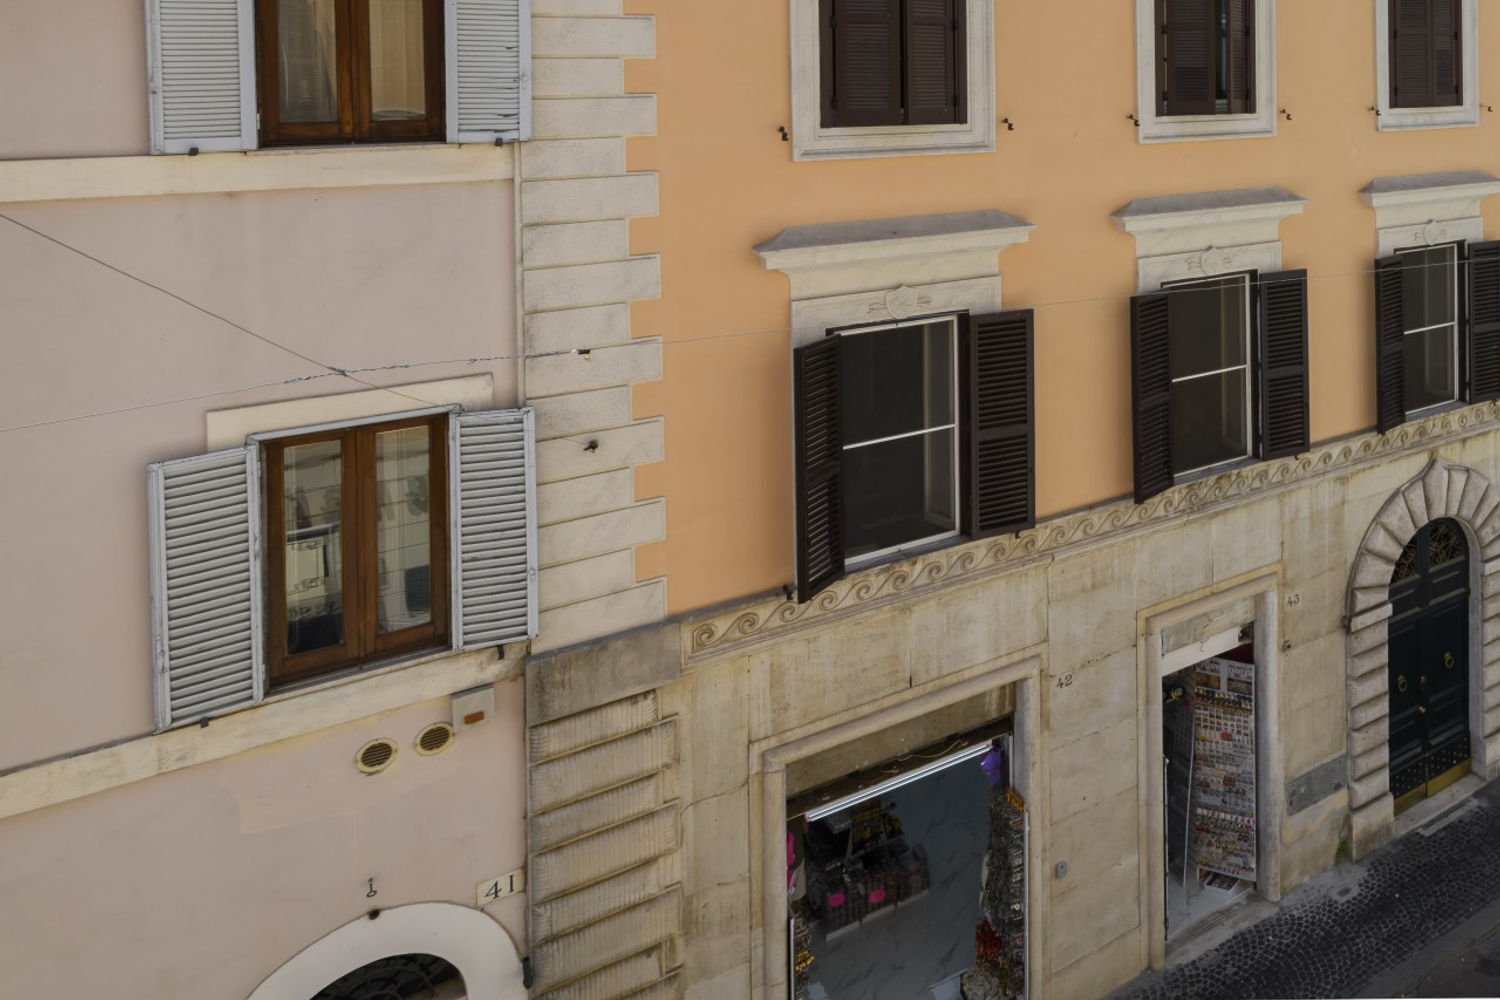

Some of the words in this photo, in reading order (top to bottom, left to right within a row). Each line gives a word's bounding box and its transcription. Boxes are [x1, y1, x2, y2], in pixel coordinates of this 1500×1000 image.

[1287, 593, 1300, 608] 43
[1056, 674, 1073, 689] 42
[484, 875, 515, 899] 41
